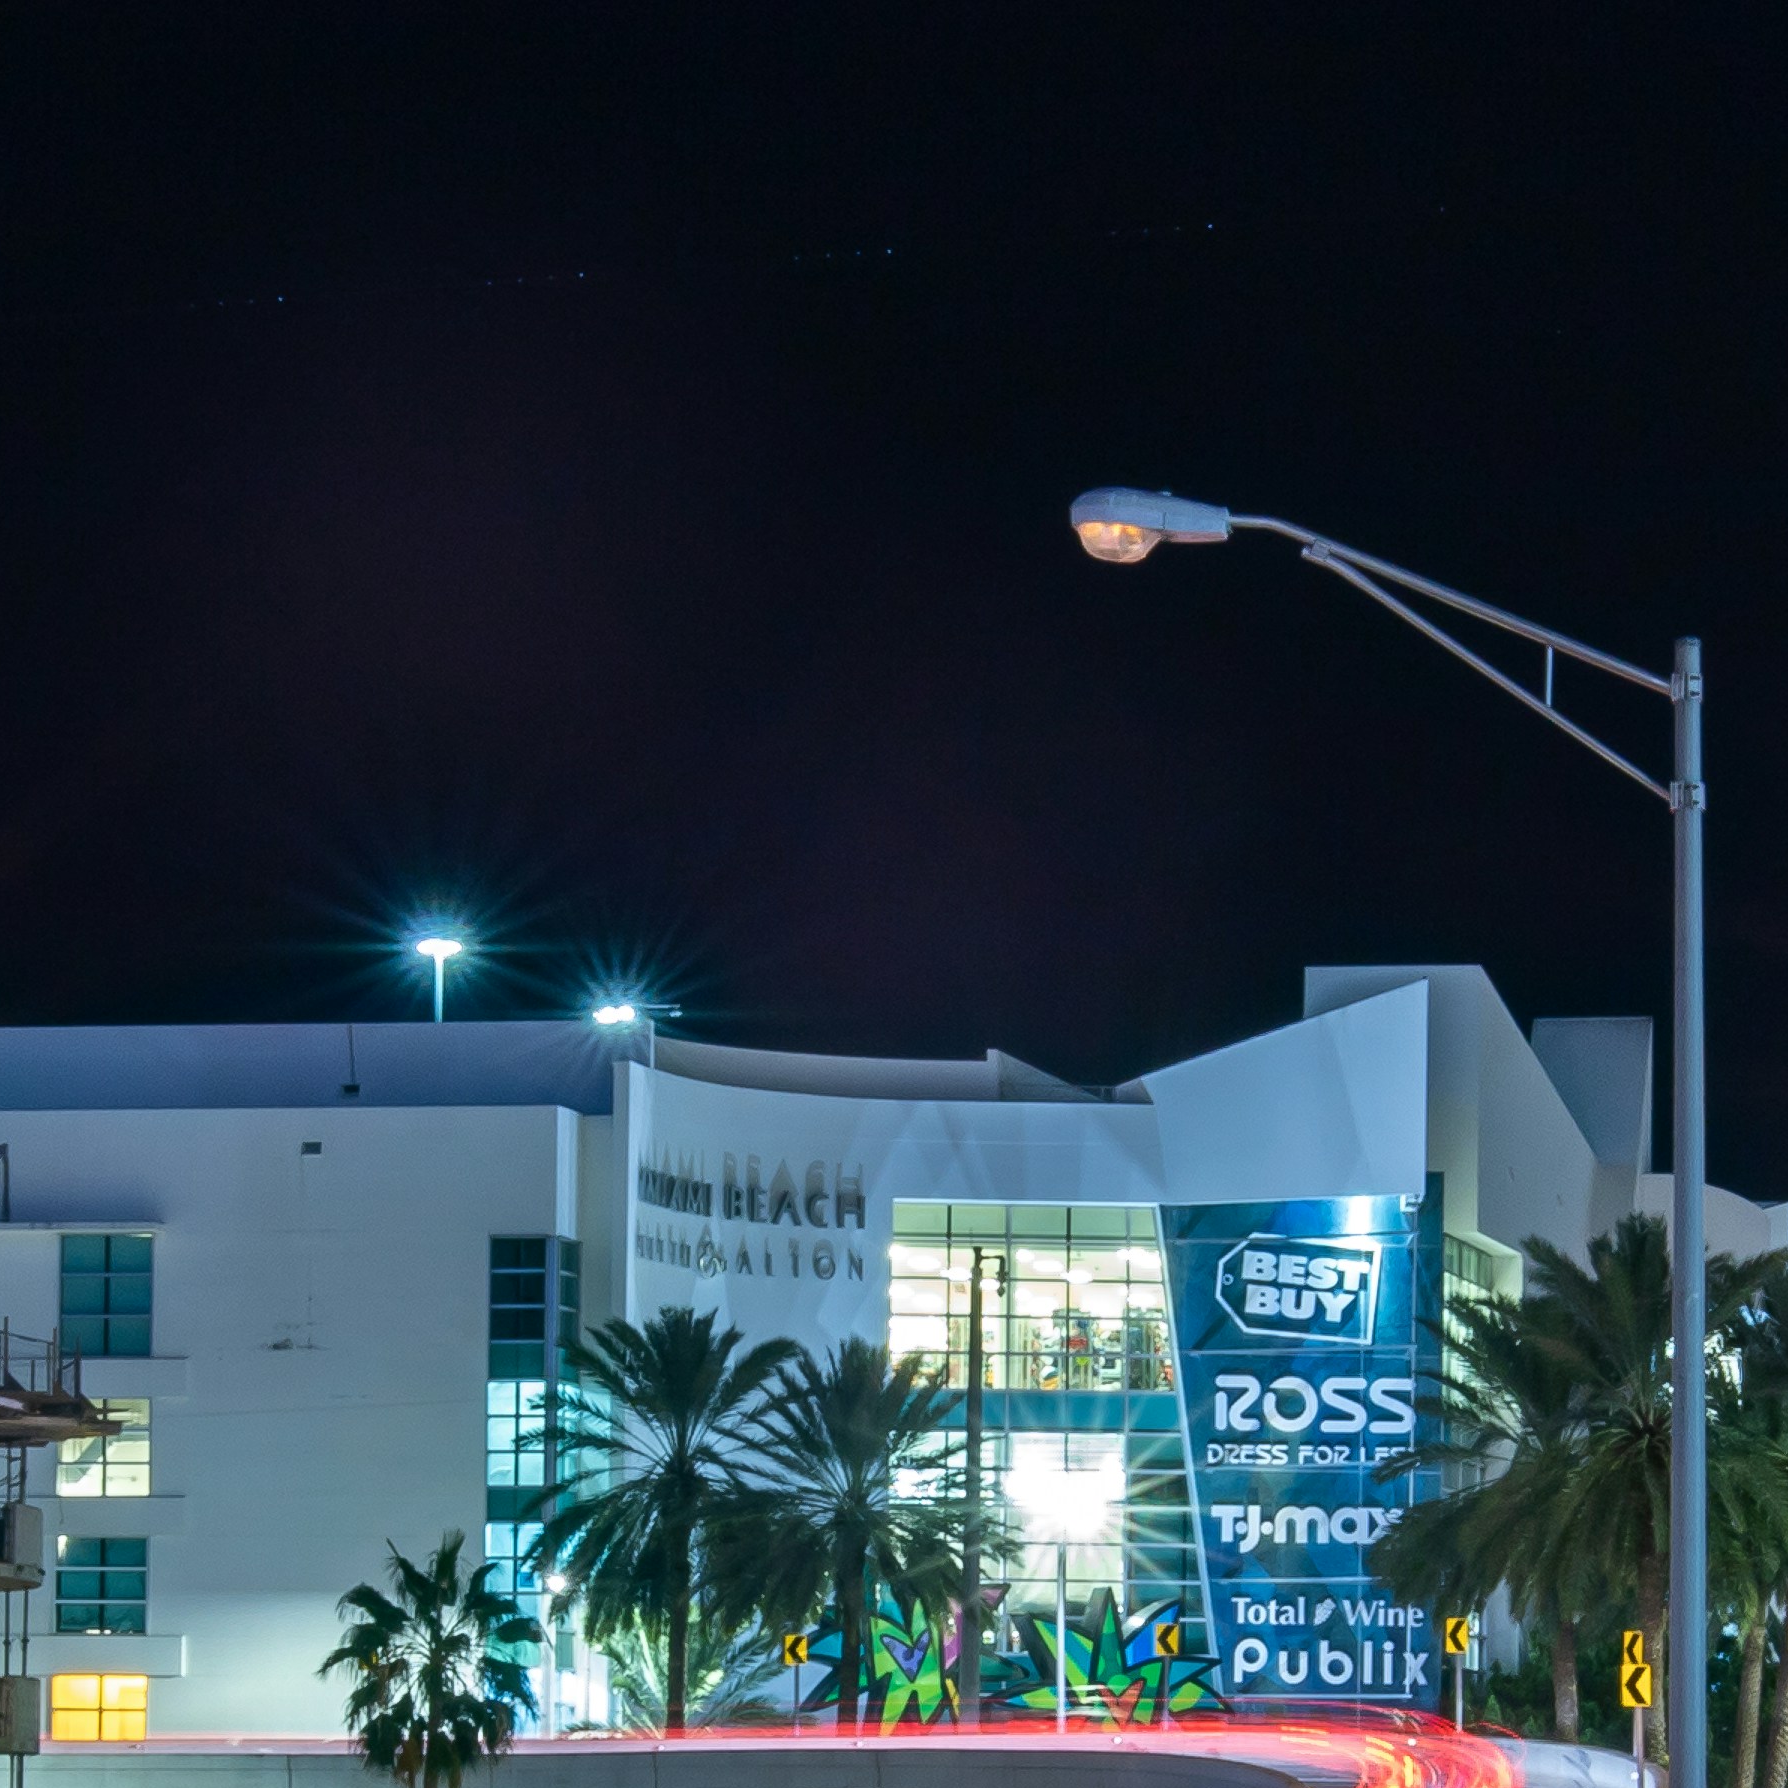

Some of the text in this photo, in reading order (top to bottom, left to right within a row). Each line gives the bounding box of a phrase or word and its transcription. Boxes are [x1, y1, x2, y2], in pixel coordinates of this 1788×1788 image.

[1242, 1250, 1371, 1292] BEST
[1244, 1283, 1356, 1324] BUY
[1215, 1374, 1417, 1435] ROSS
[1206, 1444, 1289, 1466] DRESS
[1299, 1445, 1352, 1466] FOR
[1231, 1597, 1425, 1628] Total Wine
[1233, 1637, 1430, 1686] Publix
